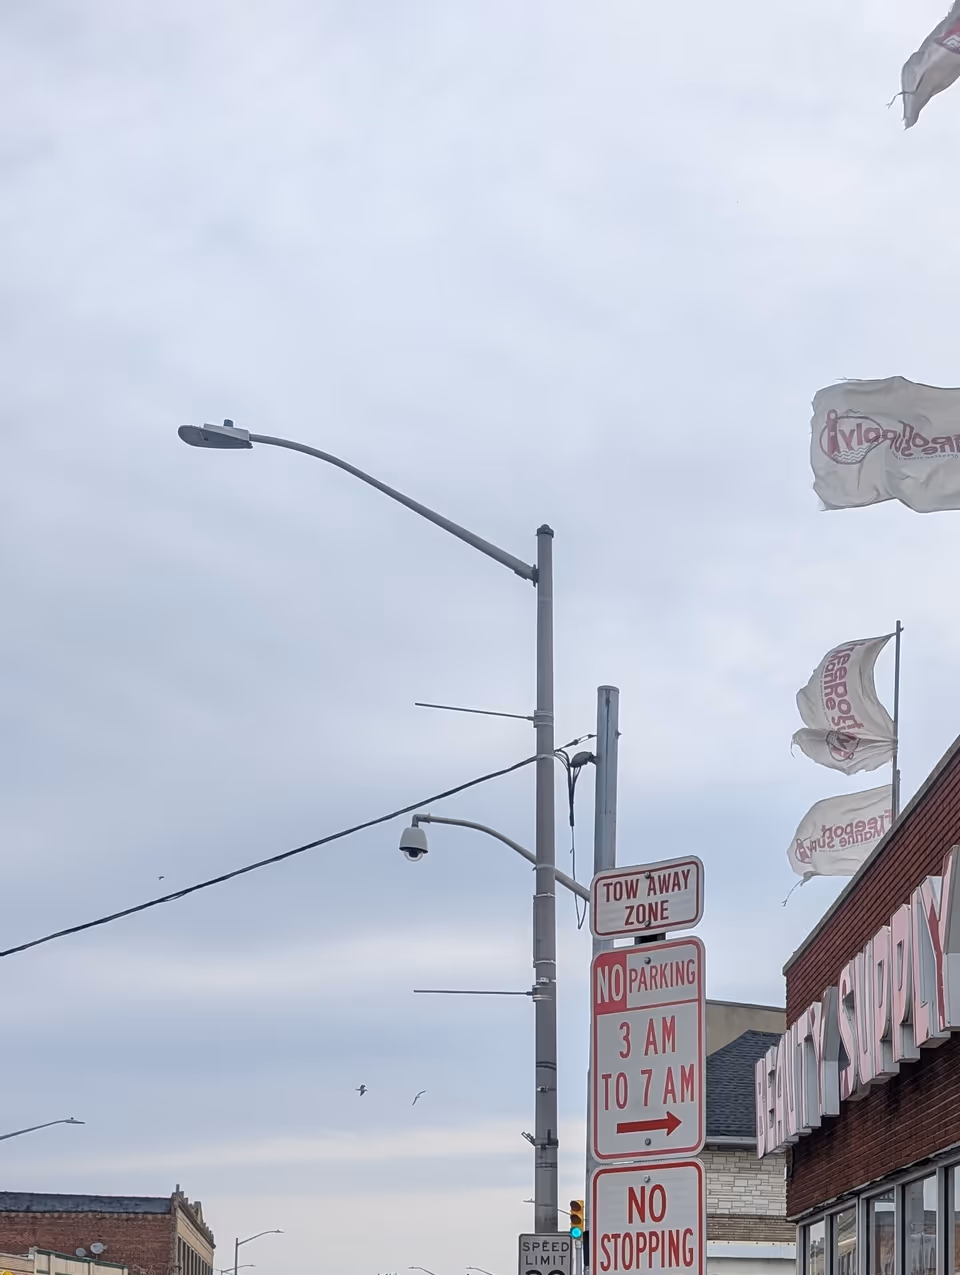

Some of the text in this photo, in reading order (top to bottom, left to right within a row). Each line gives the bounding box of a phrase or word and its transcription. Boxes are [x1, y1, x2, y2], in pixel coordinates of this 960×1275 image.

[603, 869, 691, 905] TOW AWAY
[624, 899, 669, 927] ZONE
[596, 957, 697, 1006] NO PARKING
[618, 1015, 677, 1060] 3 AM
[601, 1063, 696, 1112] TO 7 AM
[755, 986, 840, 1160] BEAUTY
[627, 1184, 667, 1225] NO
[522, 1241, 569, 1252] SPEED
[526, 1255, 566, 1266] LIMIT
[600, 1229, 694, 1272] STOPPING
